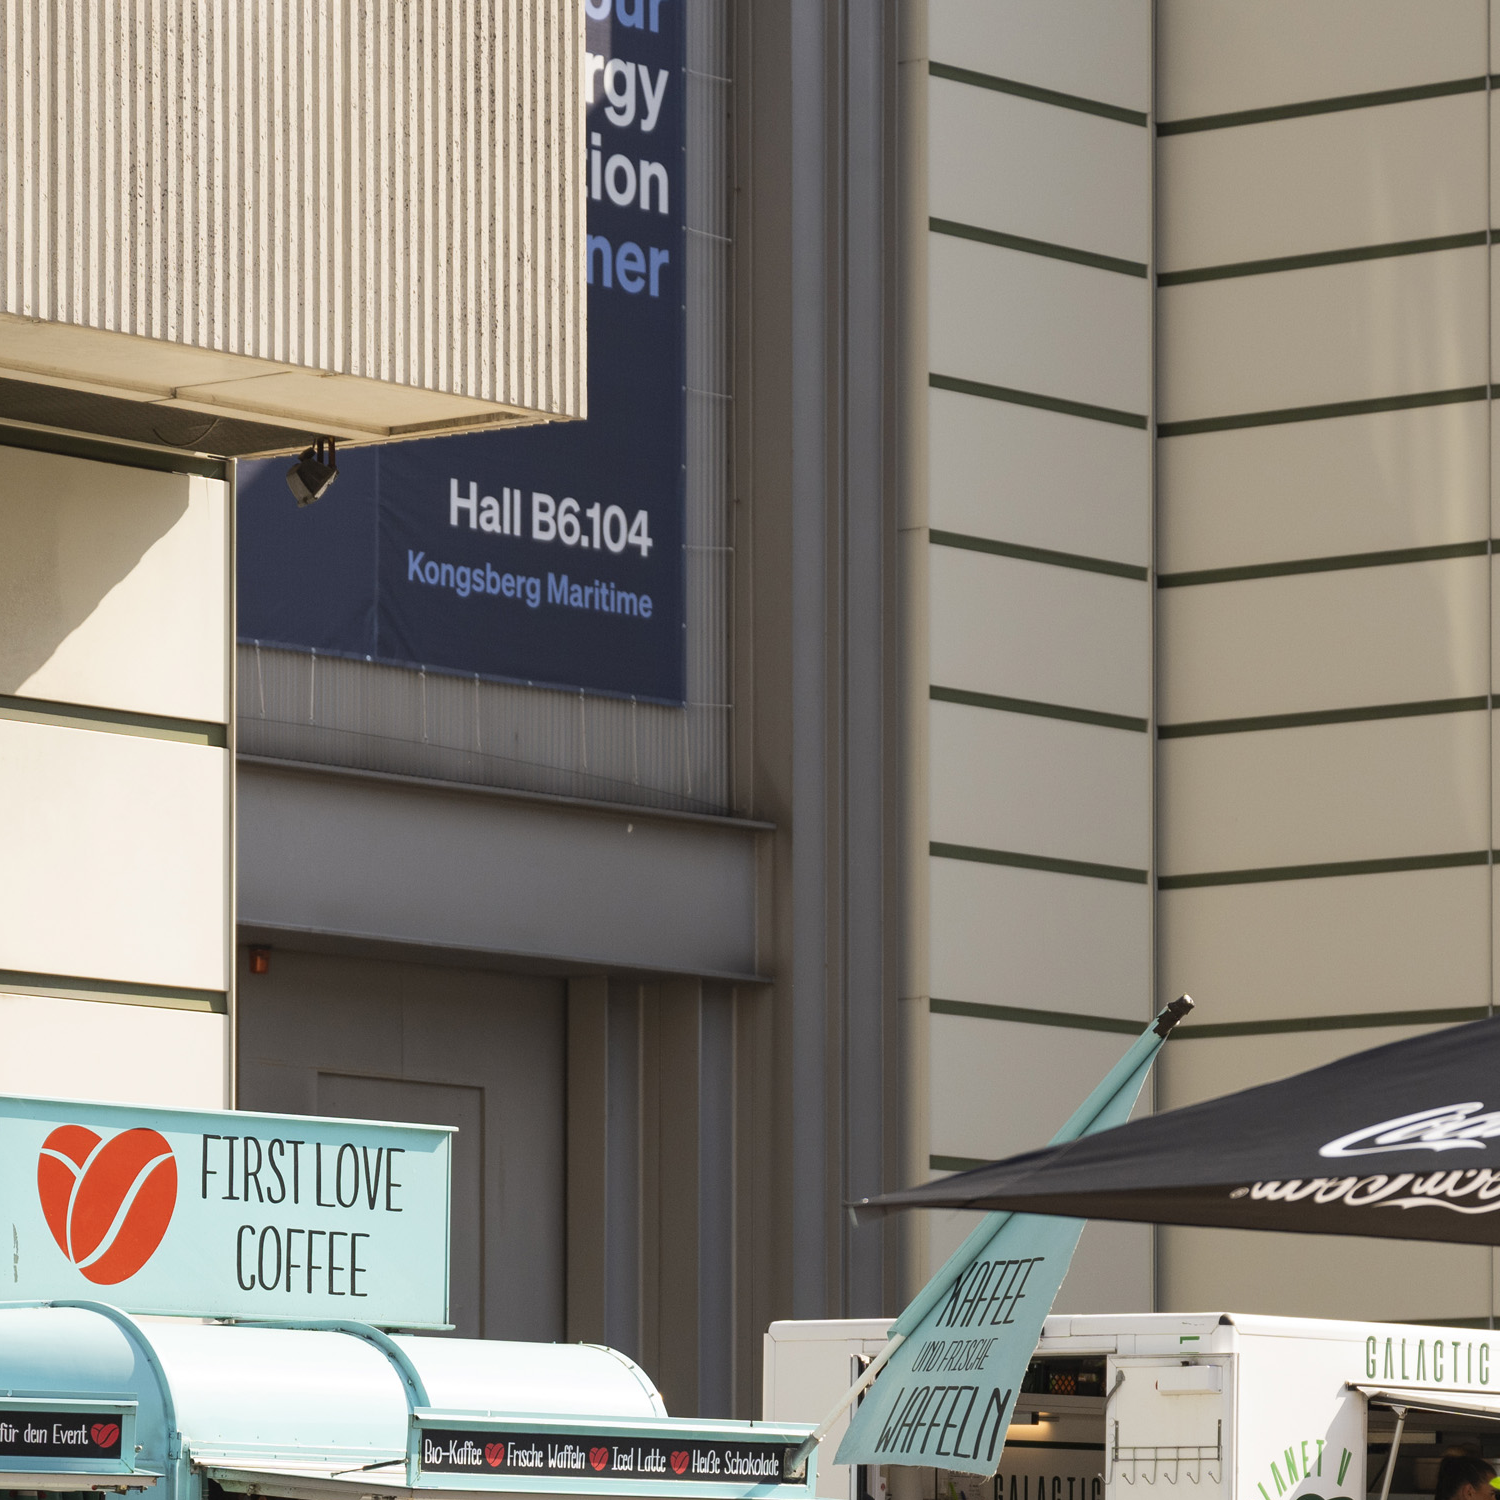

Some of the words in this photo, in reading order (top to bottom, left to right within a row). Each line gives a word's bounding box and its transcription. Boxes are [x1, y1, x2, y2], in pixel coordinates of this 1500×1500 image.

[586, 131, 669, 214] ion
[449, 478, 522, 537] Hall
[532, 492, 653, 557] B6.104
[407, 549, 542, 607] Kongsberg
[547, 572, 653, 618] Maritime
[202, 1134, 304, 1206] FIRST
[316, 1143, 405, 1213] LOVE
[236, 1224, 371, 1298] COFFEE
[936, 1257, 1045, 1328] KAFFEE
[911, 1340, 946, 1372] UND
[936, 1338, 998, 1372] FRISCHE
[1366, 1335, 1490, 1386] GALACTIC
[0, 1422, 19, 1443] für
[23, 1423, 48, 1444] dein
[52, 1424, 88, 1445] Event
[424, 1438, 482, 1466] Bio-Kaffee
[507, 1442, 543, 1467] Frische
[548, 1443, 585, 1469] Waffeln
[611, 1446, 634, 1471] Iced
[637, 1447, 666, 1473] Latte
[692, 1449, 720, 1474] Heiße
[724, 1450, 779, 1476] Schokolade
[874, 1385, 1012, 1462] WAFFELN
[1337, 1447, 1352, 1487] V
